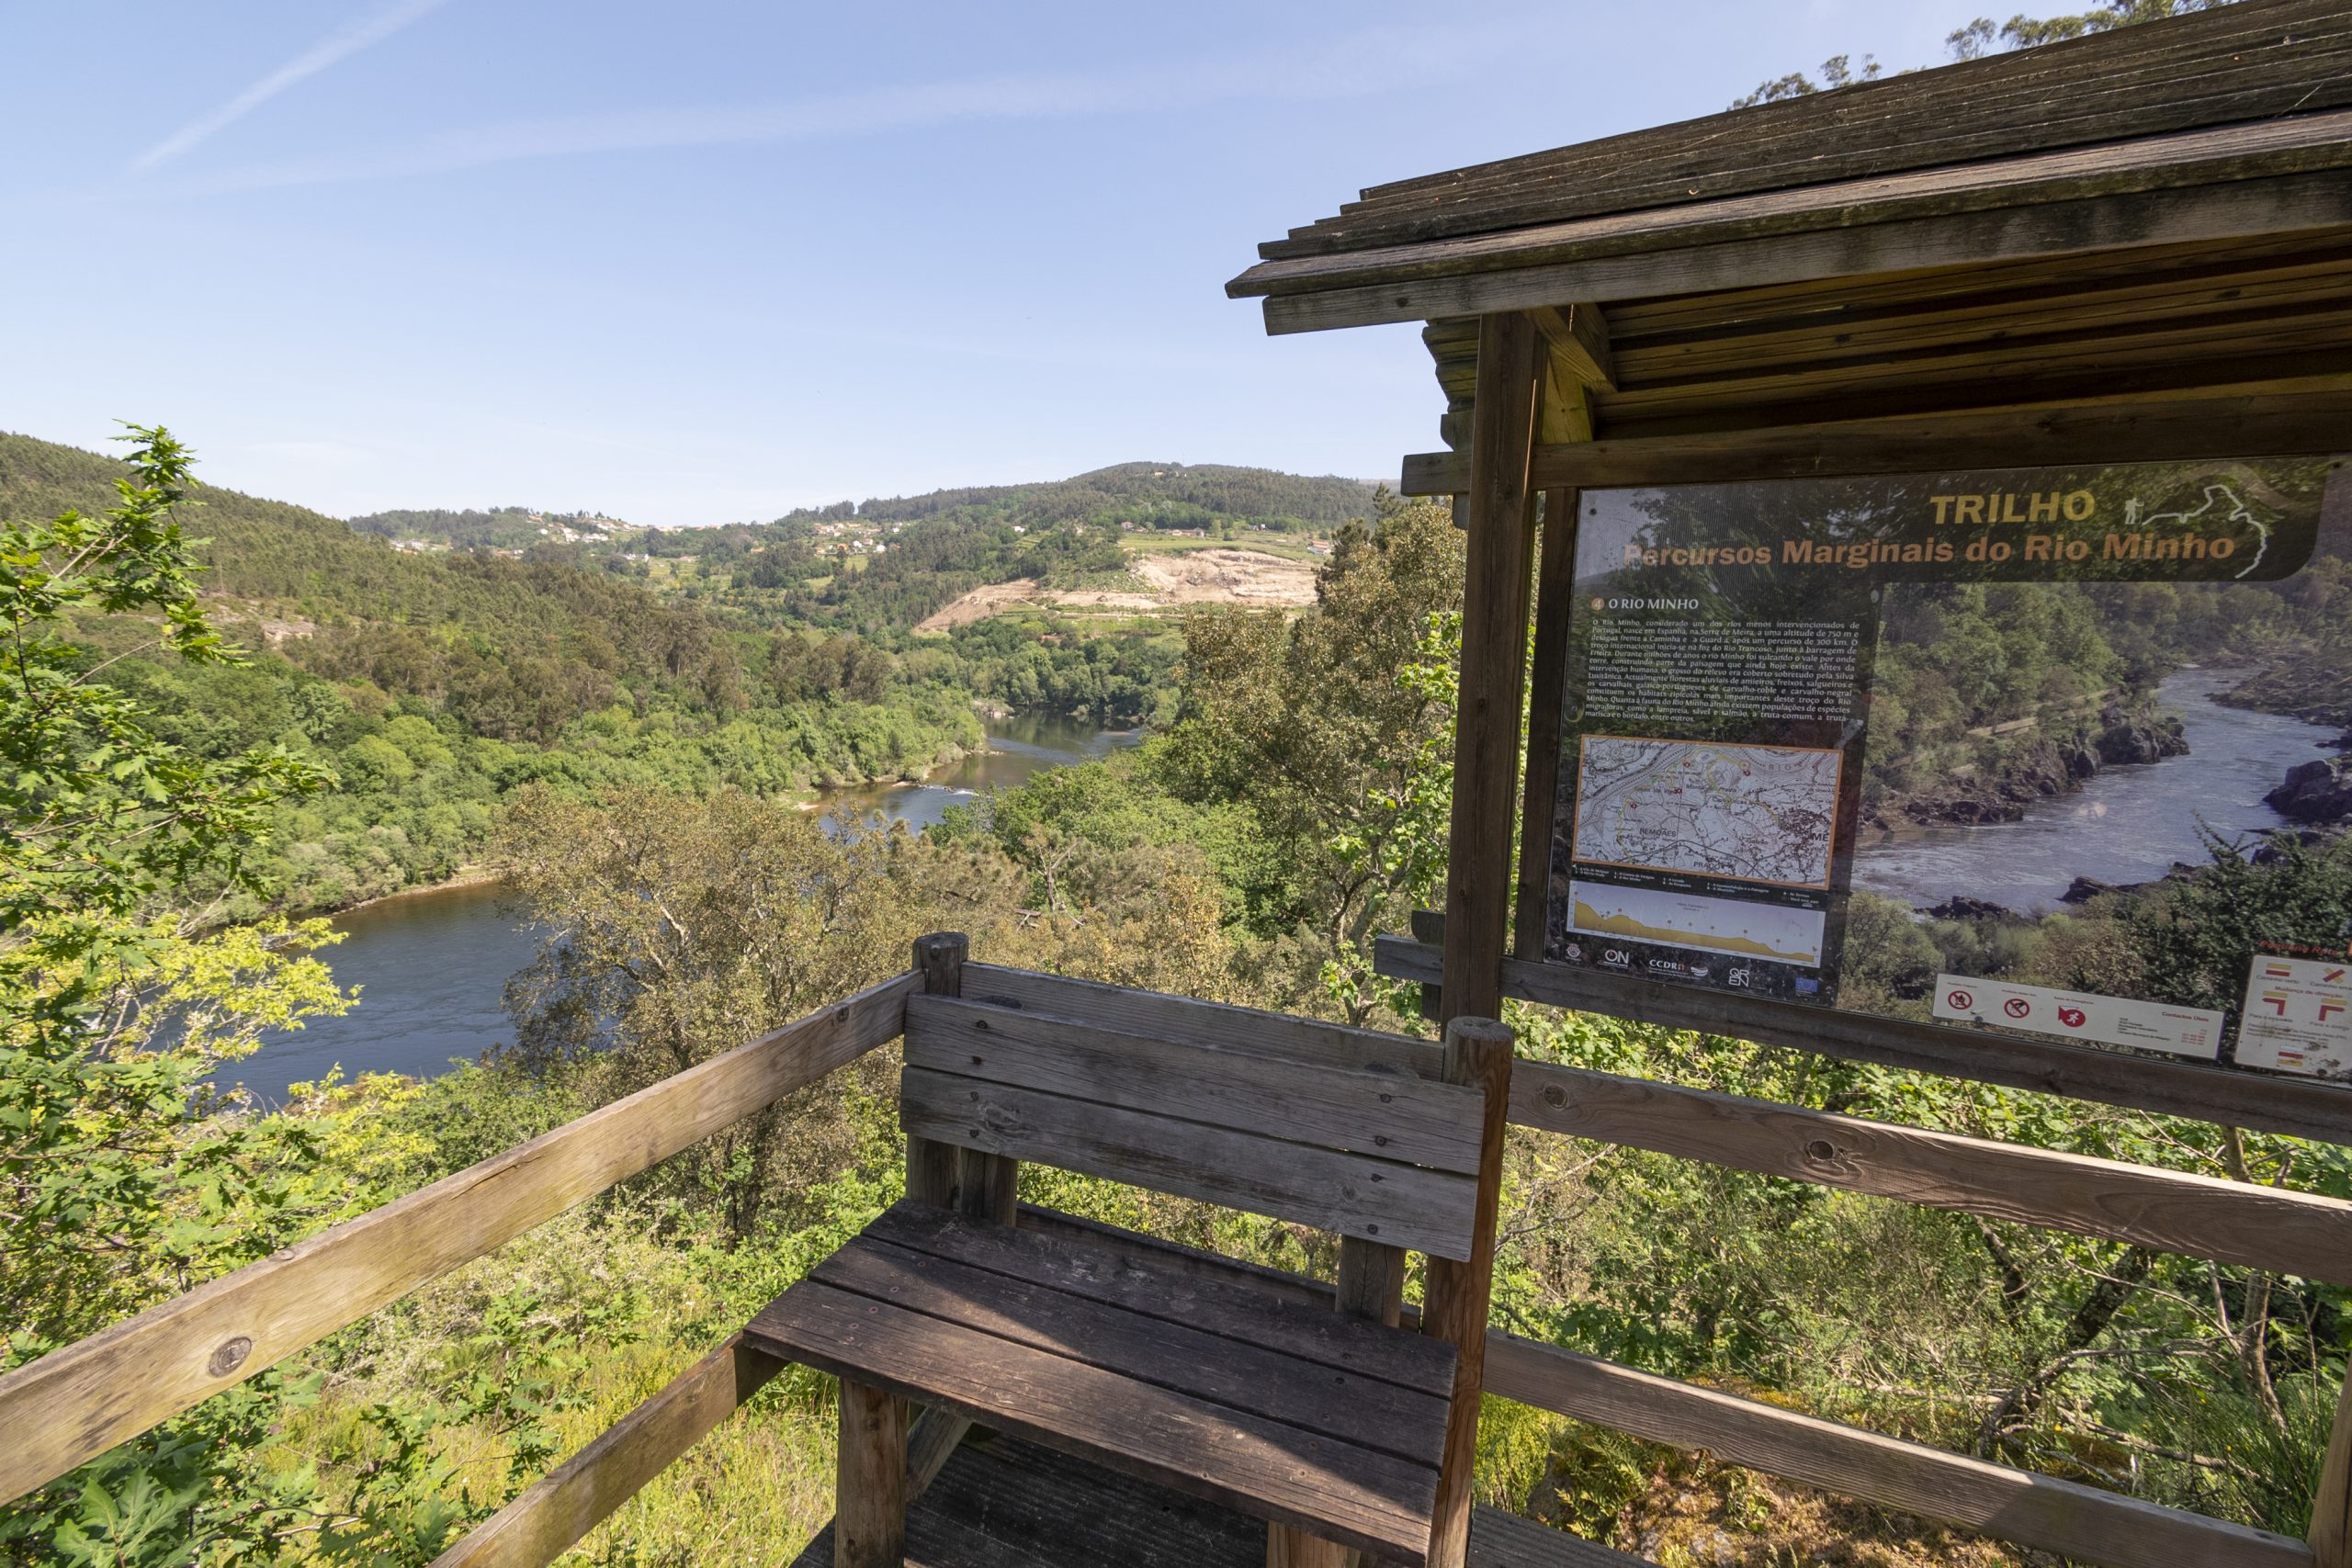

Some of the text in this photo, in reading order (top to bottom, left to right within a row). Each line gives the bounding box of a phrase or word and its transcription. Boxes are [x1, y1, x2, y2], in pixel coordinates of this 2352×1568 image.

[1929, 491, 2096, 525] TRILHO
[1623, 533, 2235, 569] Percursos Marginais do Rio Minho
[1608, 598, 1618, 609] O
[1621, 598, 1645, 609] RIO
[1647, 598, 1699, 610] MINHO
[1591, 634, 1618, 643] deságua
[1806, 647, 1844, 655] barragem
[1656, 659, 1674, 667] parte
[1690, 660, 1724, 669] paisagem
[1589, 665, 1628, 673] intervenção
[1816, 673, 1833, 681] pela
[1806, 680, 1846, 689] salgueiros
[1722, 685, 1777, 694] carvalho-roble
[1790, 688, 1852, 698] carvalho-negral
[1724, 693, 1770, 703] importantes
[1799, 697, 1820, 705] troço
[1610, 696, 1634, 704] Quanta
[1762, 703, 1805, 713] populações
[1817, 706, 1850, 715] espécies
[1604, 949, 1629, 964] ON
